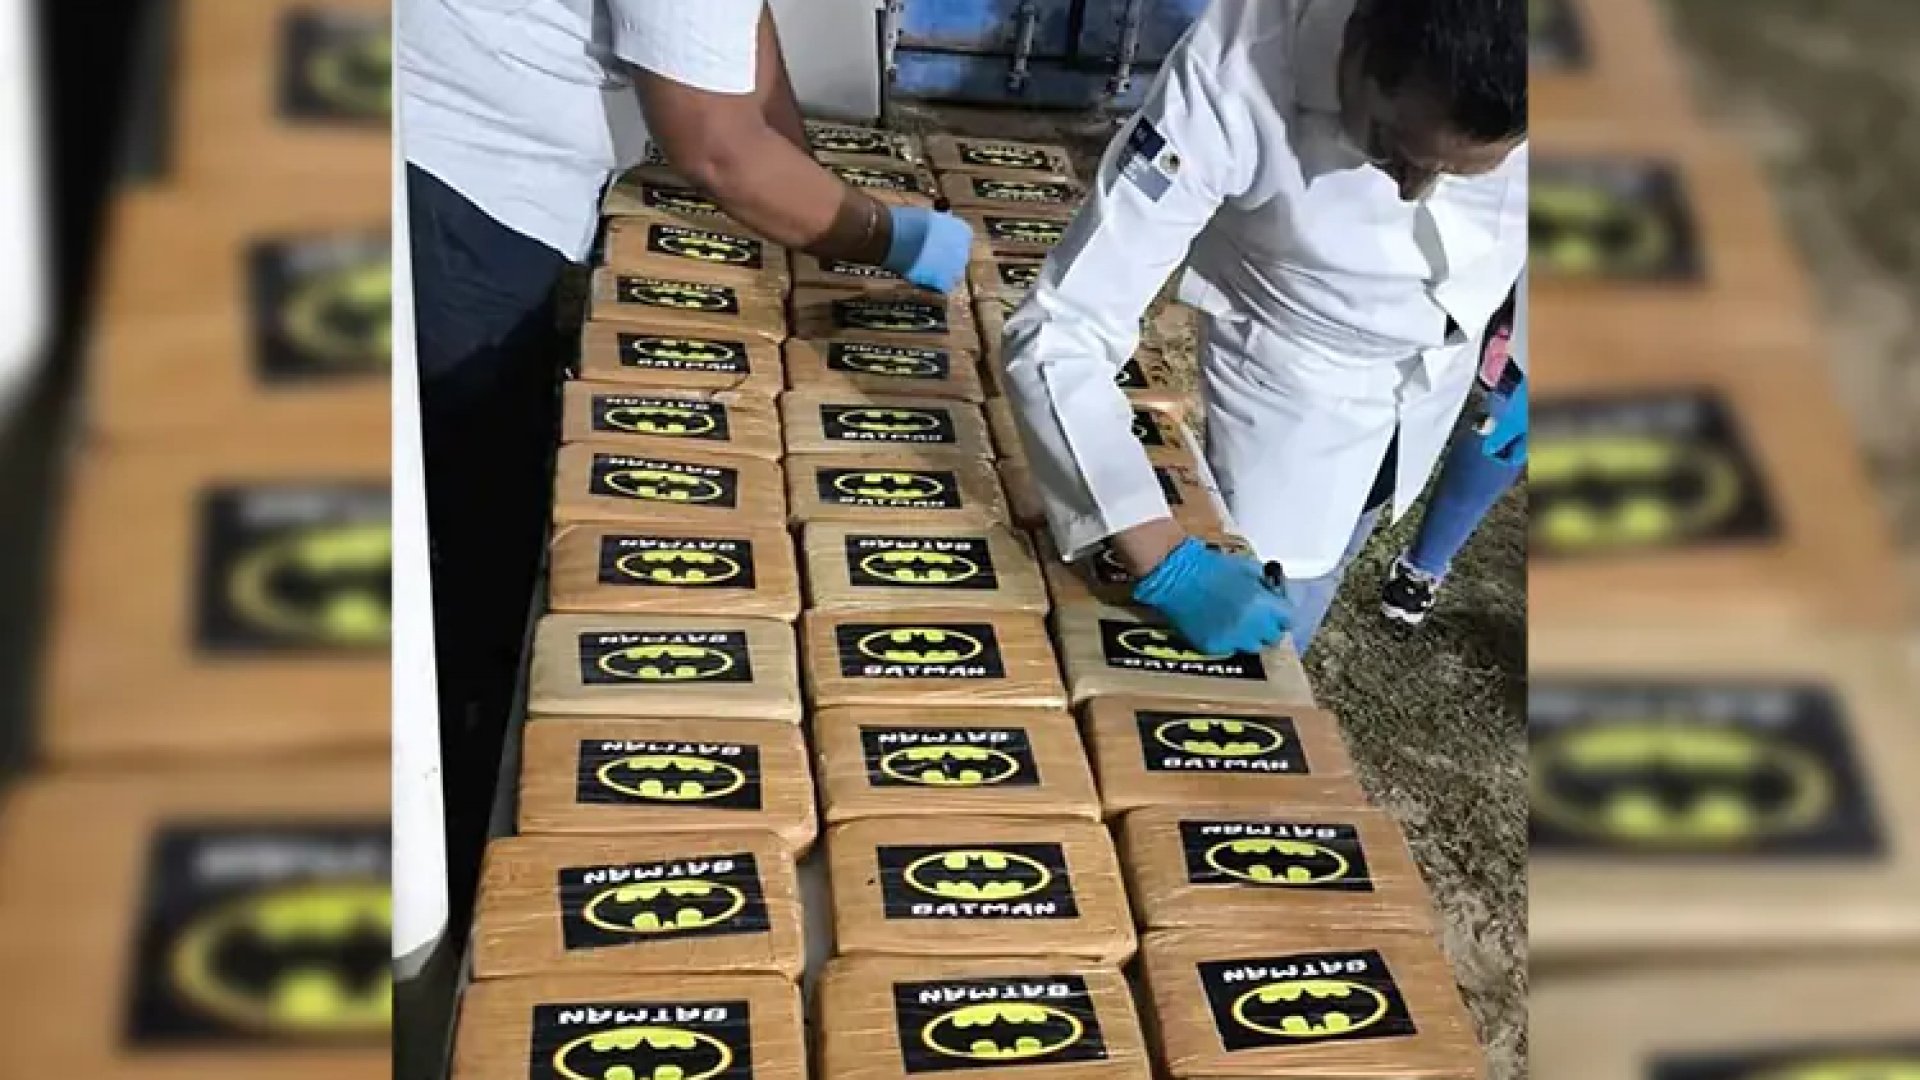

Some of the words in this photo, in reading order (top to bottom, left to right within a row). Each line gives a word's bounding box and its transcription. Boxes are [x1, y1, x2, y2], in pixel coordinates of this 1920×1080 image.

[598, 633, 728, 644] BATMAN
[864, 664, 987, 676] BATMAN
[877, 731, 1010, 743] BATMAN
[601, 740, 741, 756] BATMAN
[1162, 756, 1289, 771] BATMAN
[1201, 823, 1336, 838] BATMAN
[583, 859, 734, 884] BATMAN
[910, 902, 1056, 917] BATMAN
[1223, 958, 1368, 983] BATMAN
[918, 983, 1071, 1004] BATMAN
[558, 1006, 728, 1025] BATMAN
